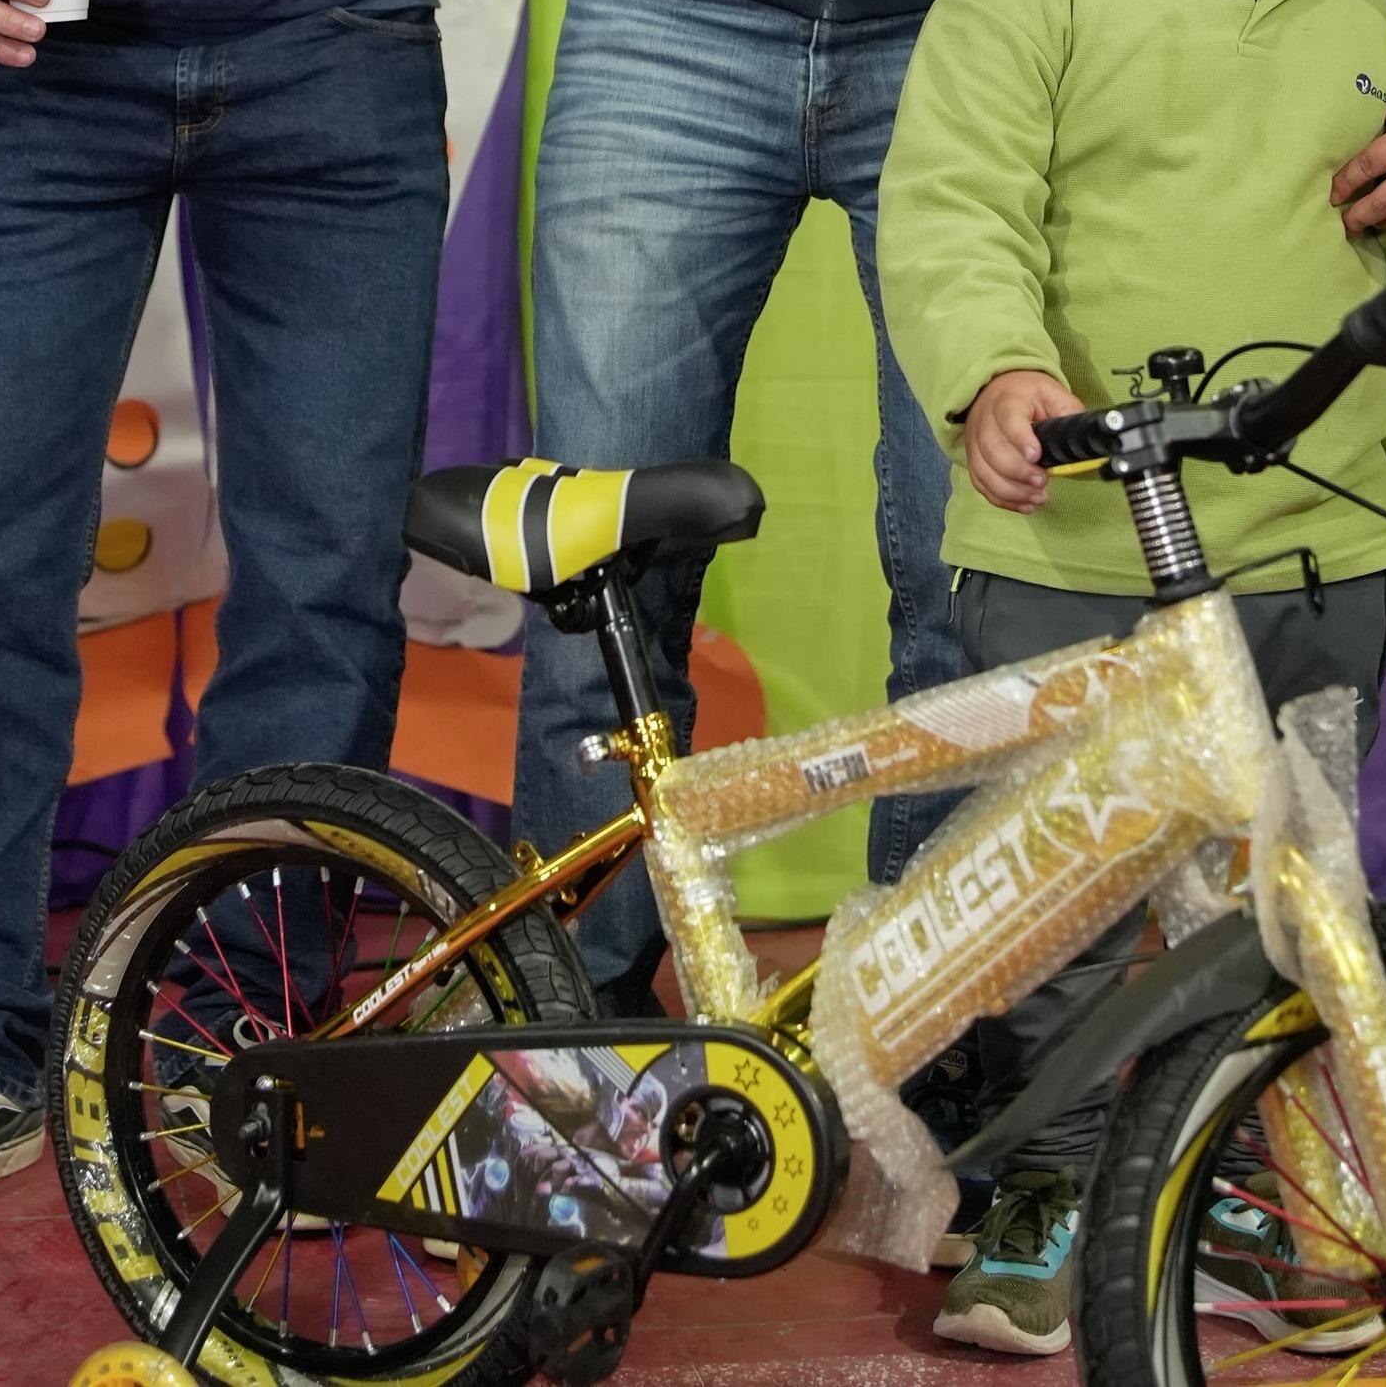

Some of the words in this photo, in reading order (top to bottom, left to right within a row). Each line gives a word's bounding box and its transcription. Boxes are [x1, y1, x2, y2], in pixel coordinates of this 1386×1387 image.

[352, 963, 412, 1026] COOLEST
[851, 816, 1036, 1015] COOLEST
[68, 997, 162, 1282] PUBG
[395, 1071, 475, 1188] COOLEST
